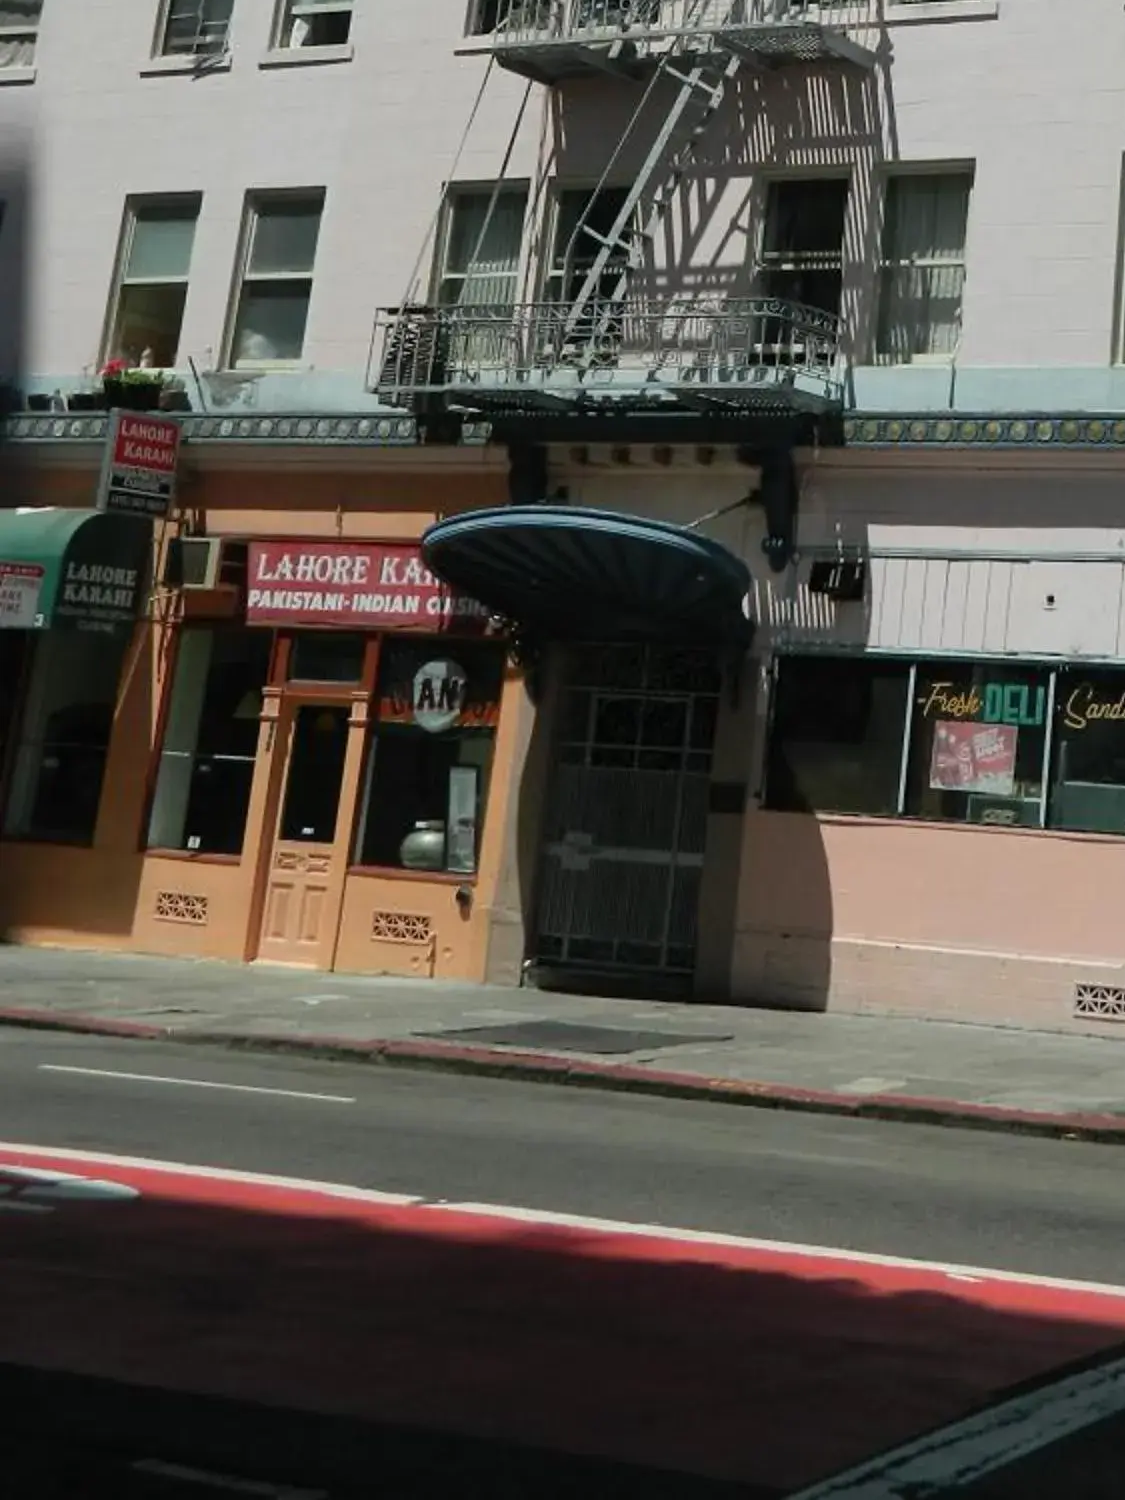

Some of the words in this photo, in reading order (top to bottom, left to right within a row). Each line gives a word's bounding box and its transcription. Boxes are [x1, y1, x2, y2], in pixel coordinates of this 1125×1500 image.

[121, 419, 175, 444] LAHORE
[124, 440, 174, 465] KARAHI
[66, 561, 138, 587] LAHORE
[257, 553, 370, 584] LAHORE
[63, 583, 135, 608] KARAHI
[923, 683, 980, 716] Fresh
[983, 683, 1045, 725] DELI
